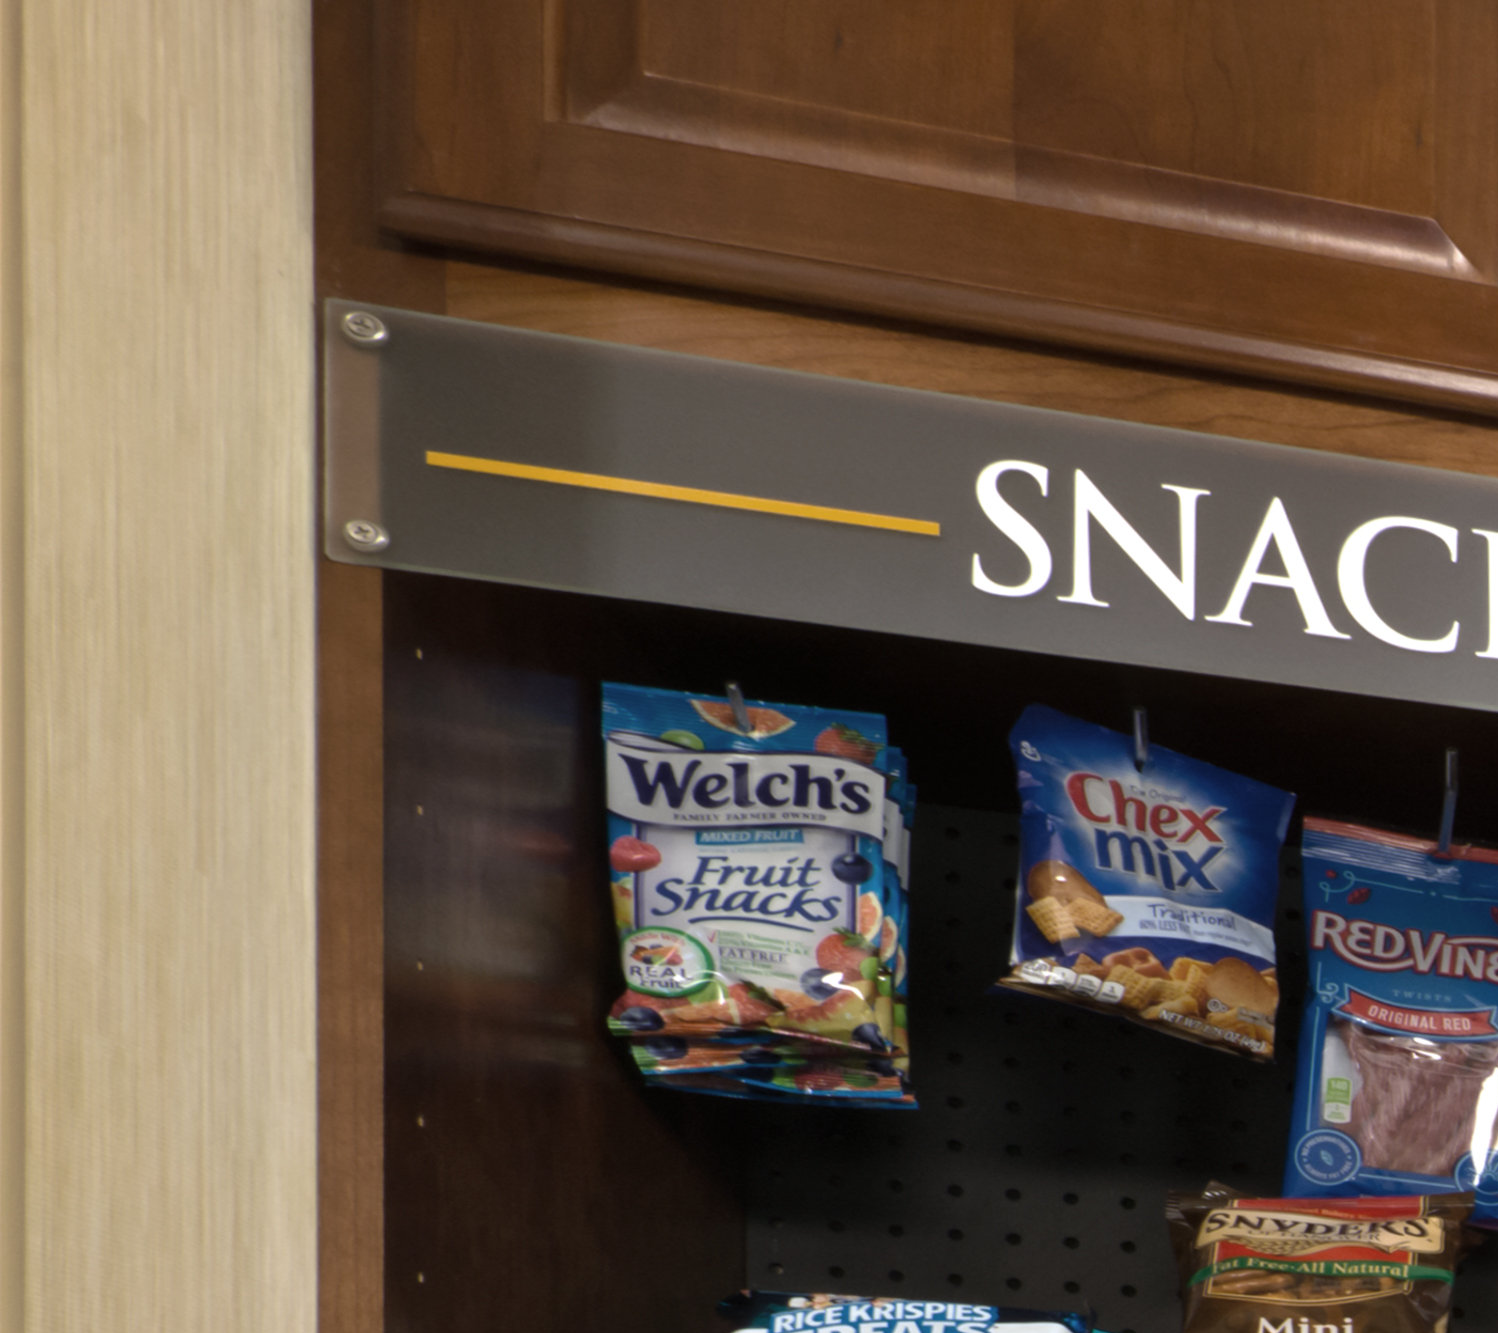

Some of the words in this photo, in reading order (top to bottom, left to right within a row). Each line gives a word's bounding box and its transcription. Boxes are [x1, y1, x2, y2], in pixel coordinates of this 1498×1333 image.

[618, 753, 872, 815] Welch's
[1064, 771, 1230, 845] Chex
[700, 831, 750, 844] MIXED
[753, 829, 800, 843] FRUIT
[686, 855, 822, 889] Fruit
[650, 877, 842, 922] Snacks
[1147, 902, 1237, 932] Traditional
[1367, 1005, 1440, 1030] ORIGINAL
[1442, 1016, 1472, 1032] RED
[773, 1307, 843, 1333] RICE
[847, 1302, 992, 1324] KRISPIES
